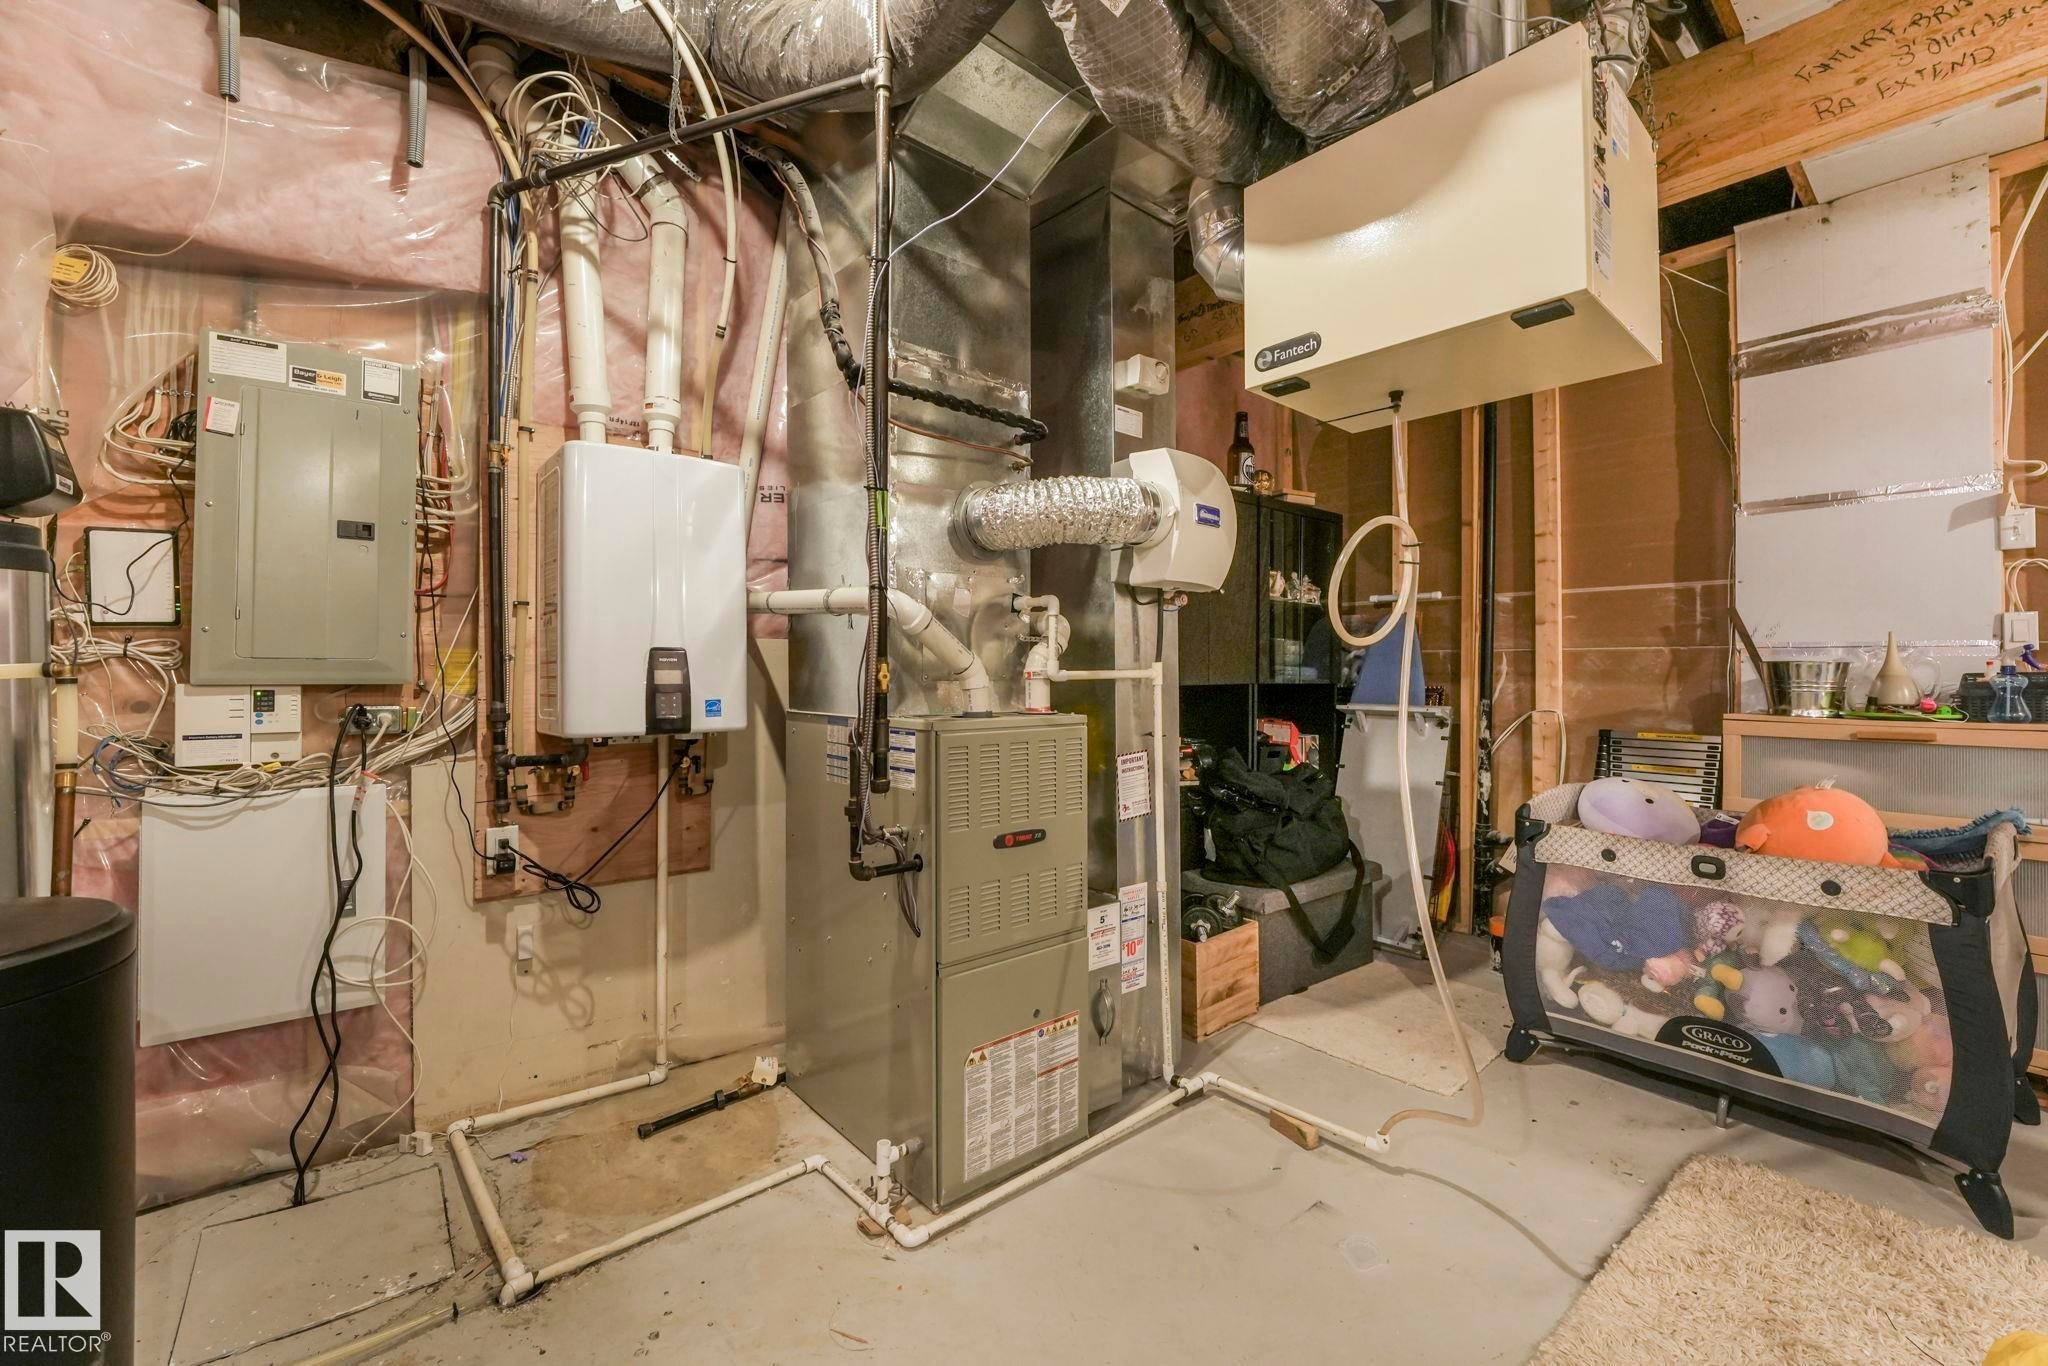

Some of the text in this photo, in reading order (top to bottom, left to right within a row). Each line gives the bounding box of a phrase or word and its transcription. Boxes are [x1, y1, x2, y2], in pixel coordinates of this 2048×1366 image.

[1810, 45, 1996, 121] RA EXTEND
[1273, 338, 1318, 362] Fantech
[293, 367, 316, 379] Bayer
[324, 373, 343, 382] Leigh
[1120, 755, 1145, 766] IMPORTANT
[1691, 1027, 1744, 1049] GRACO
